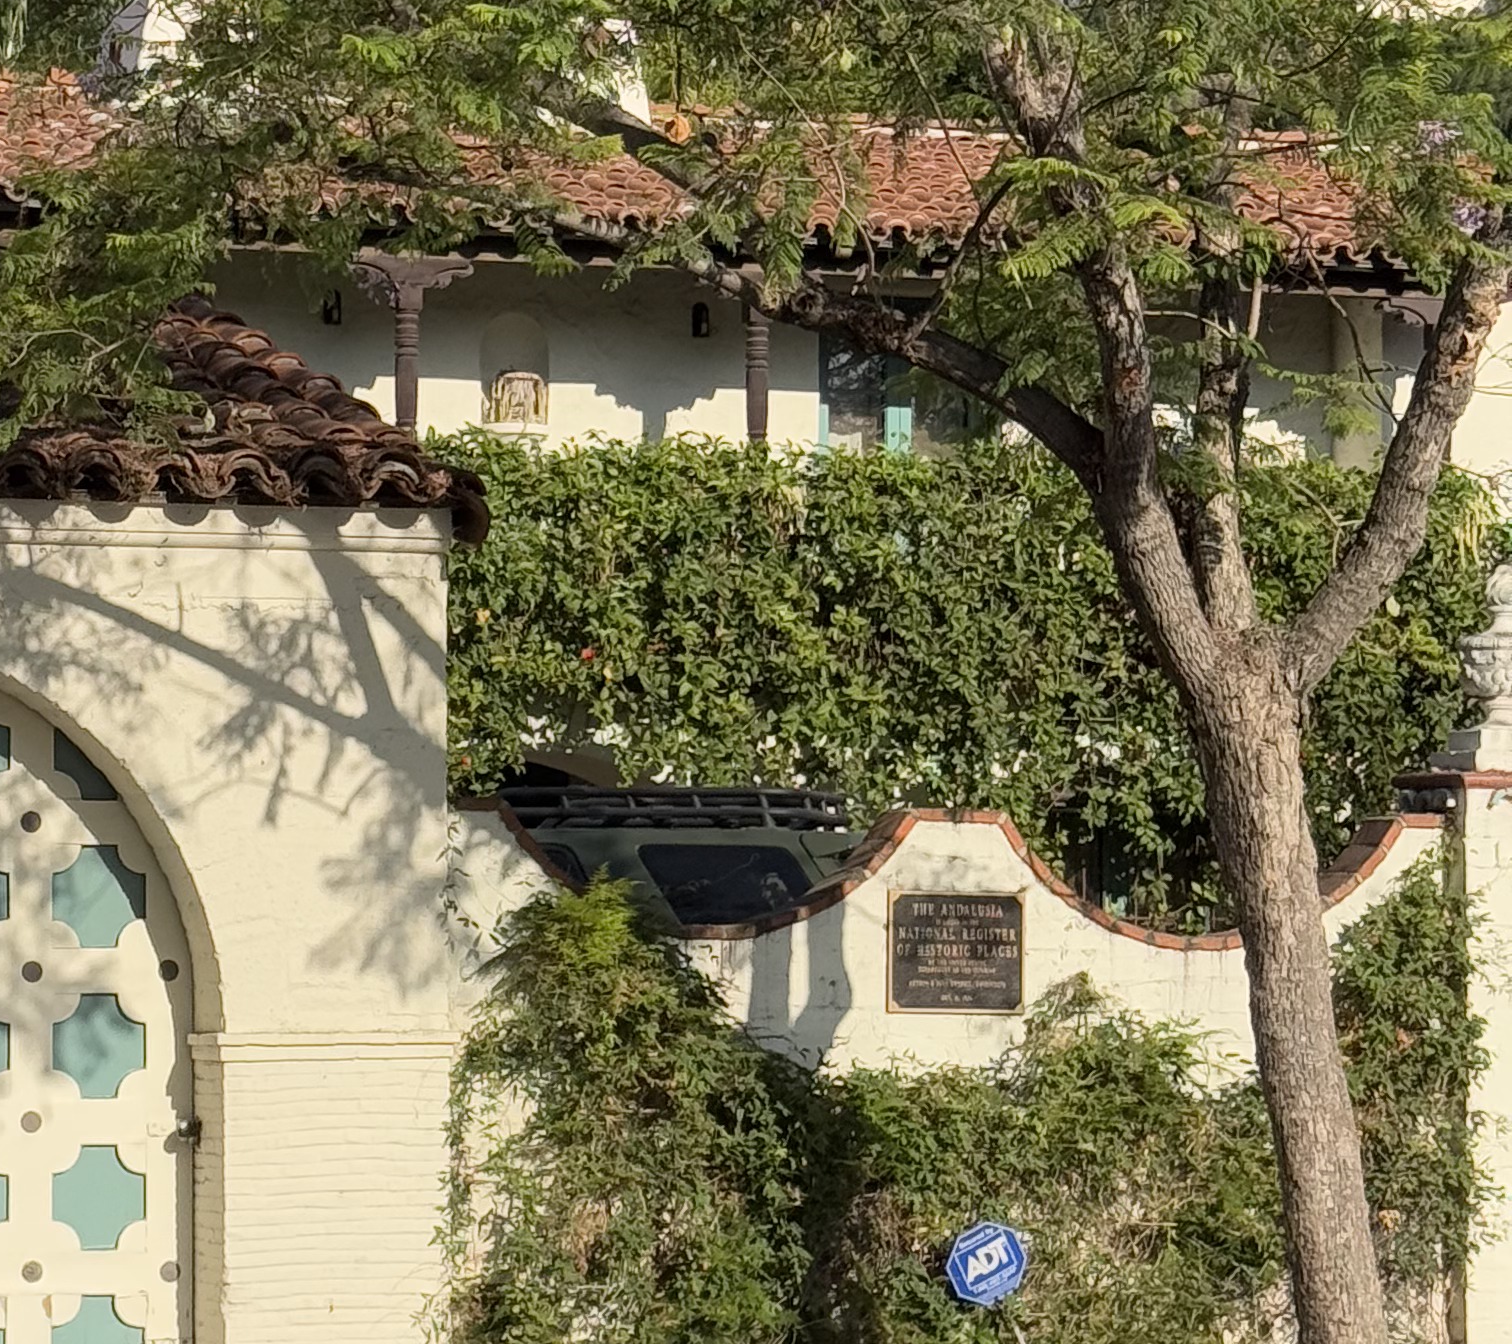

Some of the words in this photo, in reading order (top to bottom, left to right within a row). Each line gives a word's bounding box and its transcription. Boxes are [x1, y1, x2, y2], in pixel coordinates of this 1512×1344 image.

[912, 902, 934, 917] THE
[940, 903, 1004, 918] ANDALUSIA
[898, 927, 956, 941] NATIONAL
[962, 928, 1017, 942] REGISTER
[896, 944, 910, 957] OF
[977, 945, 1018, 959] PLACES
[966, 1236, 1009, 1285] ADT
